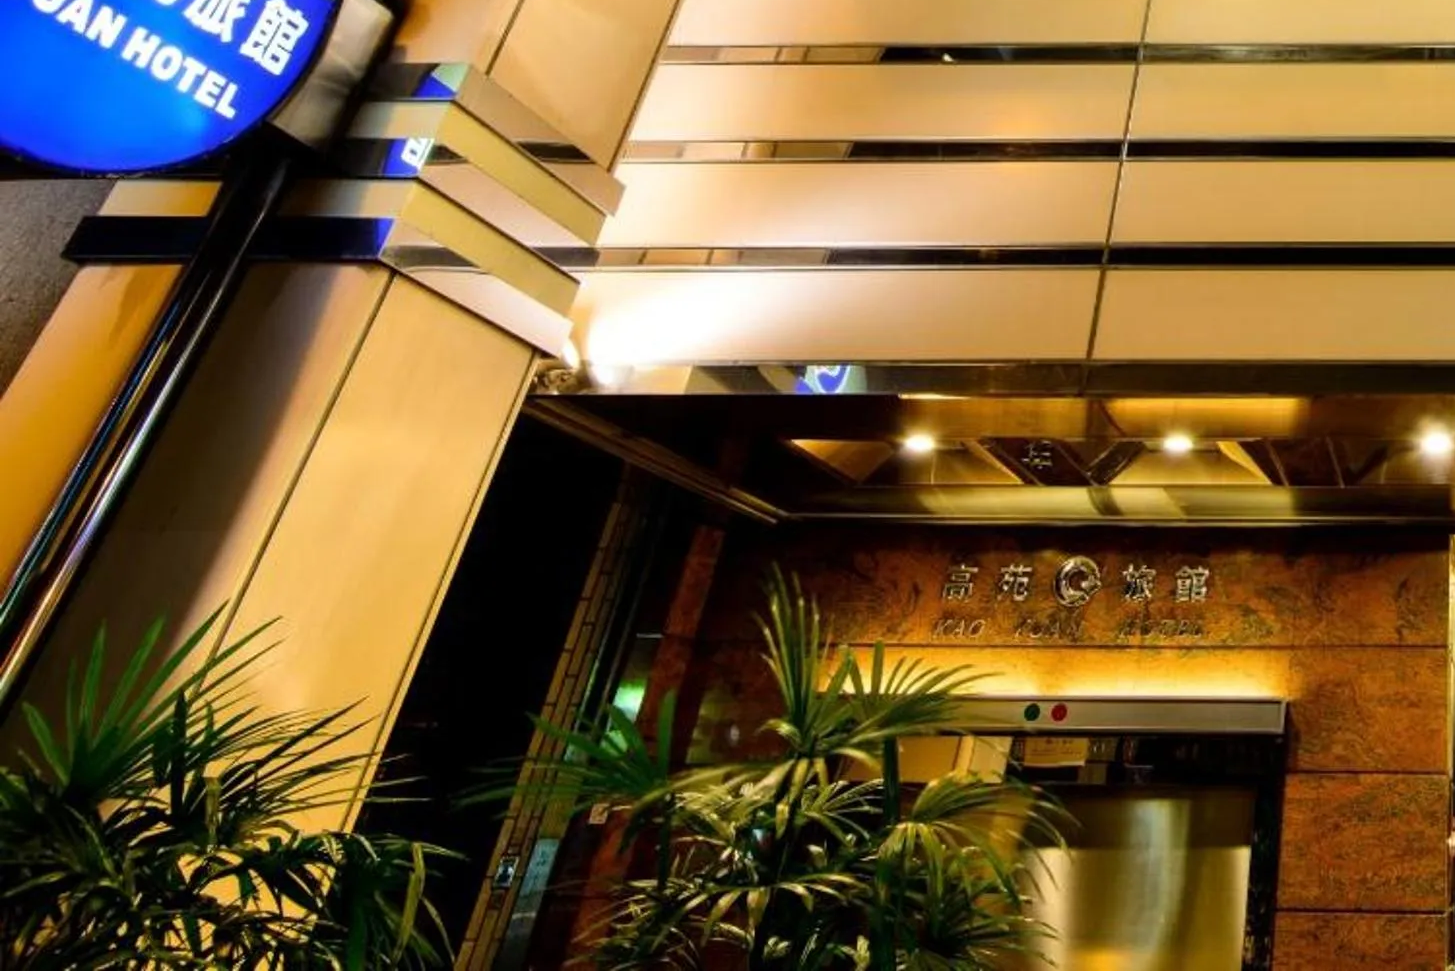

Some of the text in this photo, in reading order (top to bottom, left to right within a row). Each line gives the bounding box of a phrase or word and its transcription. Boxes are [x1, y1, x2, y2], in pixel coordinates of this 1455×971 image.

[121, 27, 242, 119] HOTEL
[941, 564, 1032, 603] 高苑
[933, 619, 987, 638] KAO
